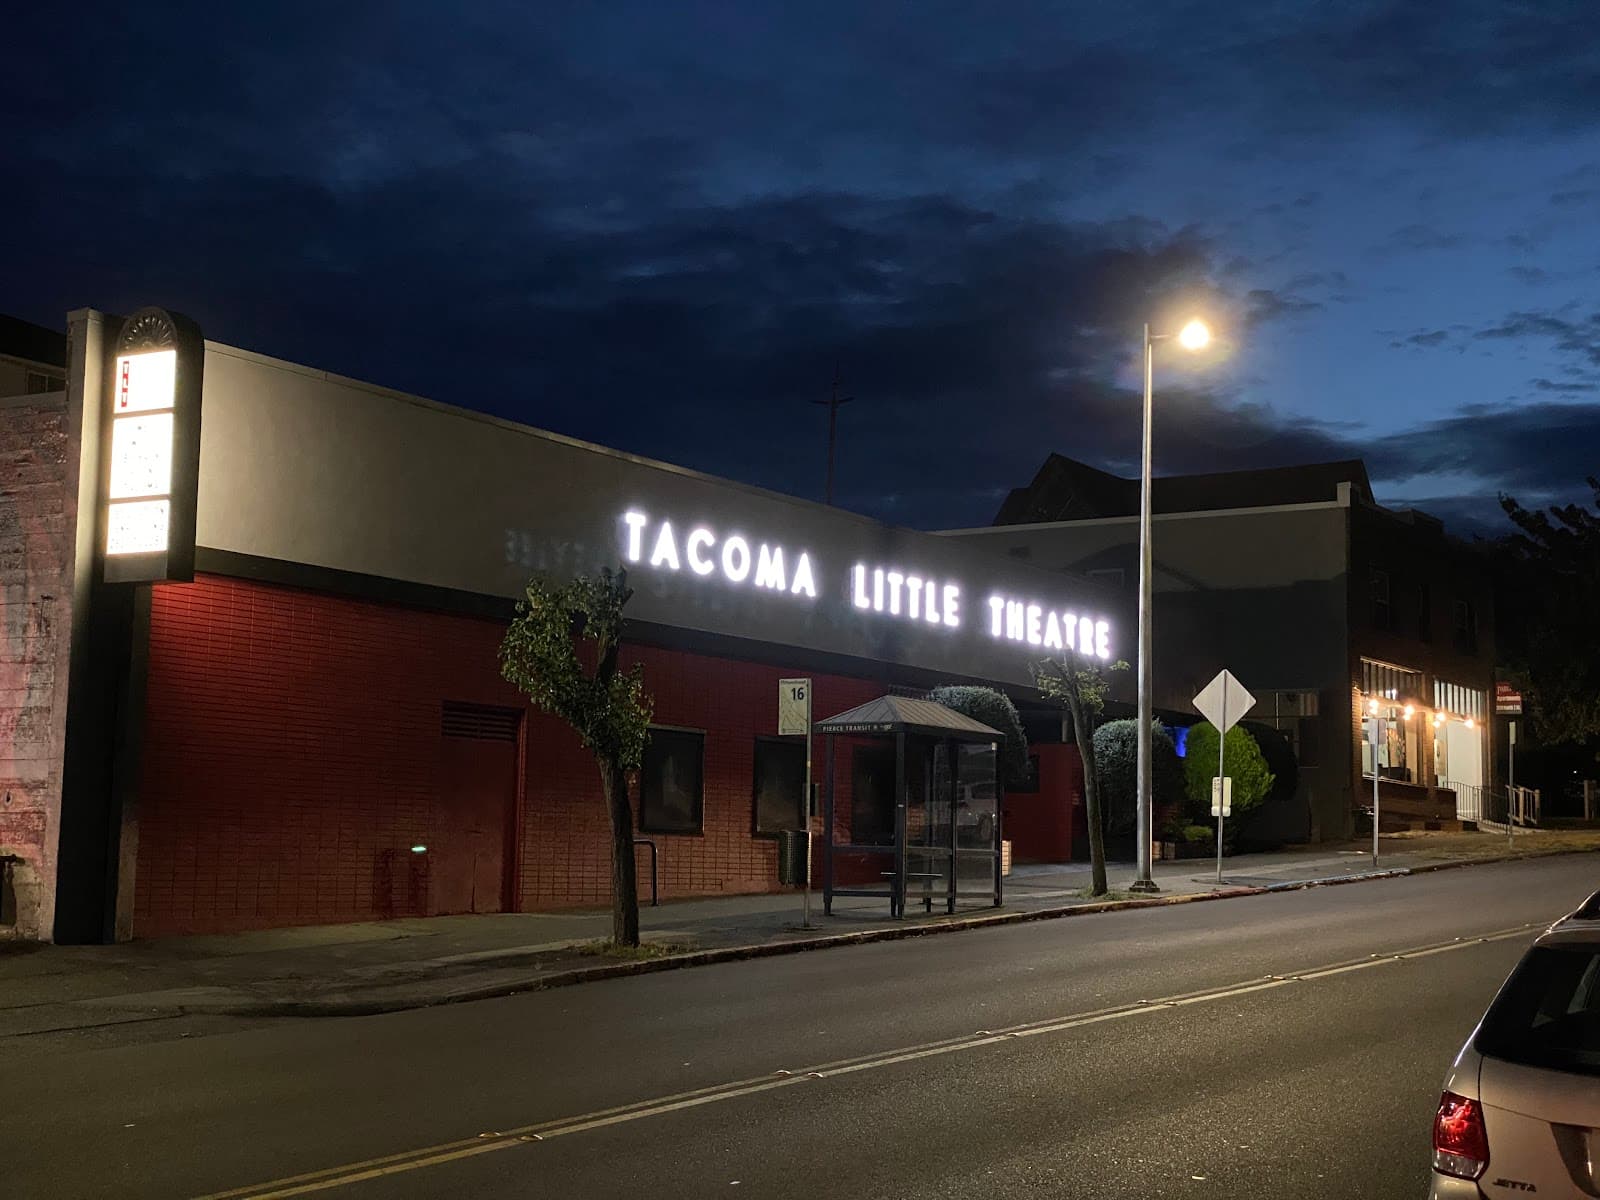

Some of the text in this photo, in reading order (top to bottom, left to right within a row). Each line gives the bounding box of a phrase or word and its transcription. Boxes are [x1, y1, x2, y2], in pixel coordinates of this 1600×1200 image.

[624, 510, 1111, 661] TACOMA LITTLE THEATRE
[791, 687, 805, 701] 16
[1492, 1178, 1537, 1193] JETTA
